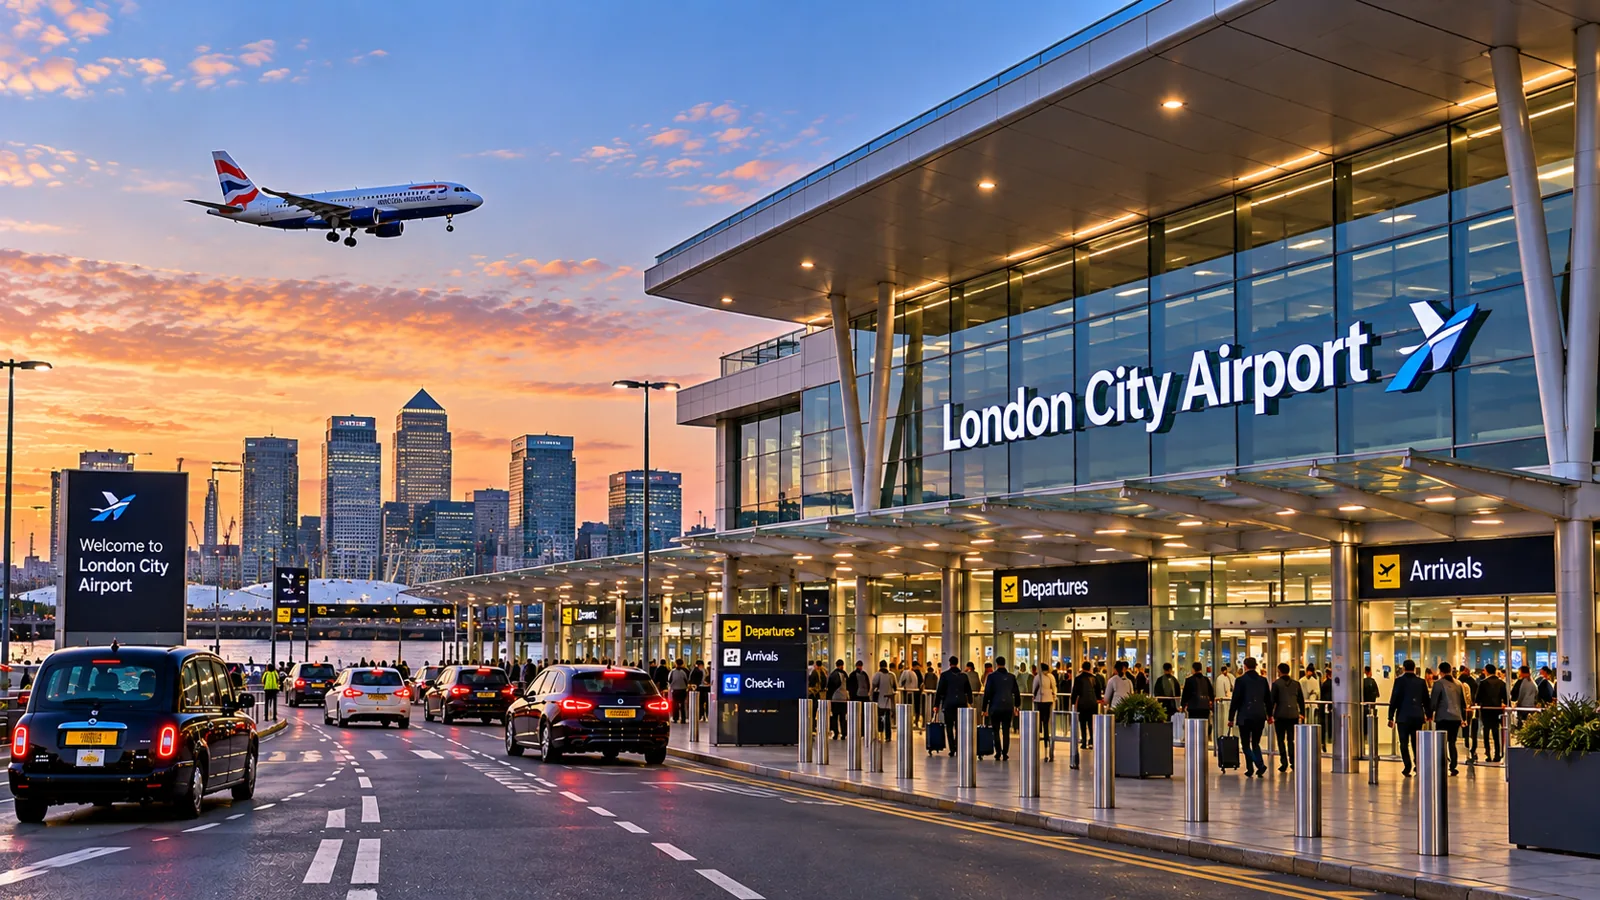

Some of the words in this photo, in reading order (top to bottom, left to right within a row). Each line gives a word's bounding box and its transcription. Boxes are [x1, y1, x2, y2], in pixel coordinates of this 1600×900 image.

[943, 387, 1074, 451] London
[1085, 368, 1176, 433] City
[1182, 320, 1369, 415] Airport
[79, 538, 145, 553] Welcome
[148, 539, 163, 553] to
[79, 557, 136, 573] London
[139, 558, 169, 577] City
[1409, 556, 1483, 582] Arrivals
[78, 577, 133, 596] Airport
[1022, 578, 1089, 602] Departures
[745, 624, 795, 640] Departures
[745, 650, 779, 662] Arrivals
[744, 677, 785, 689] Check-in
